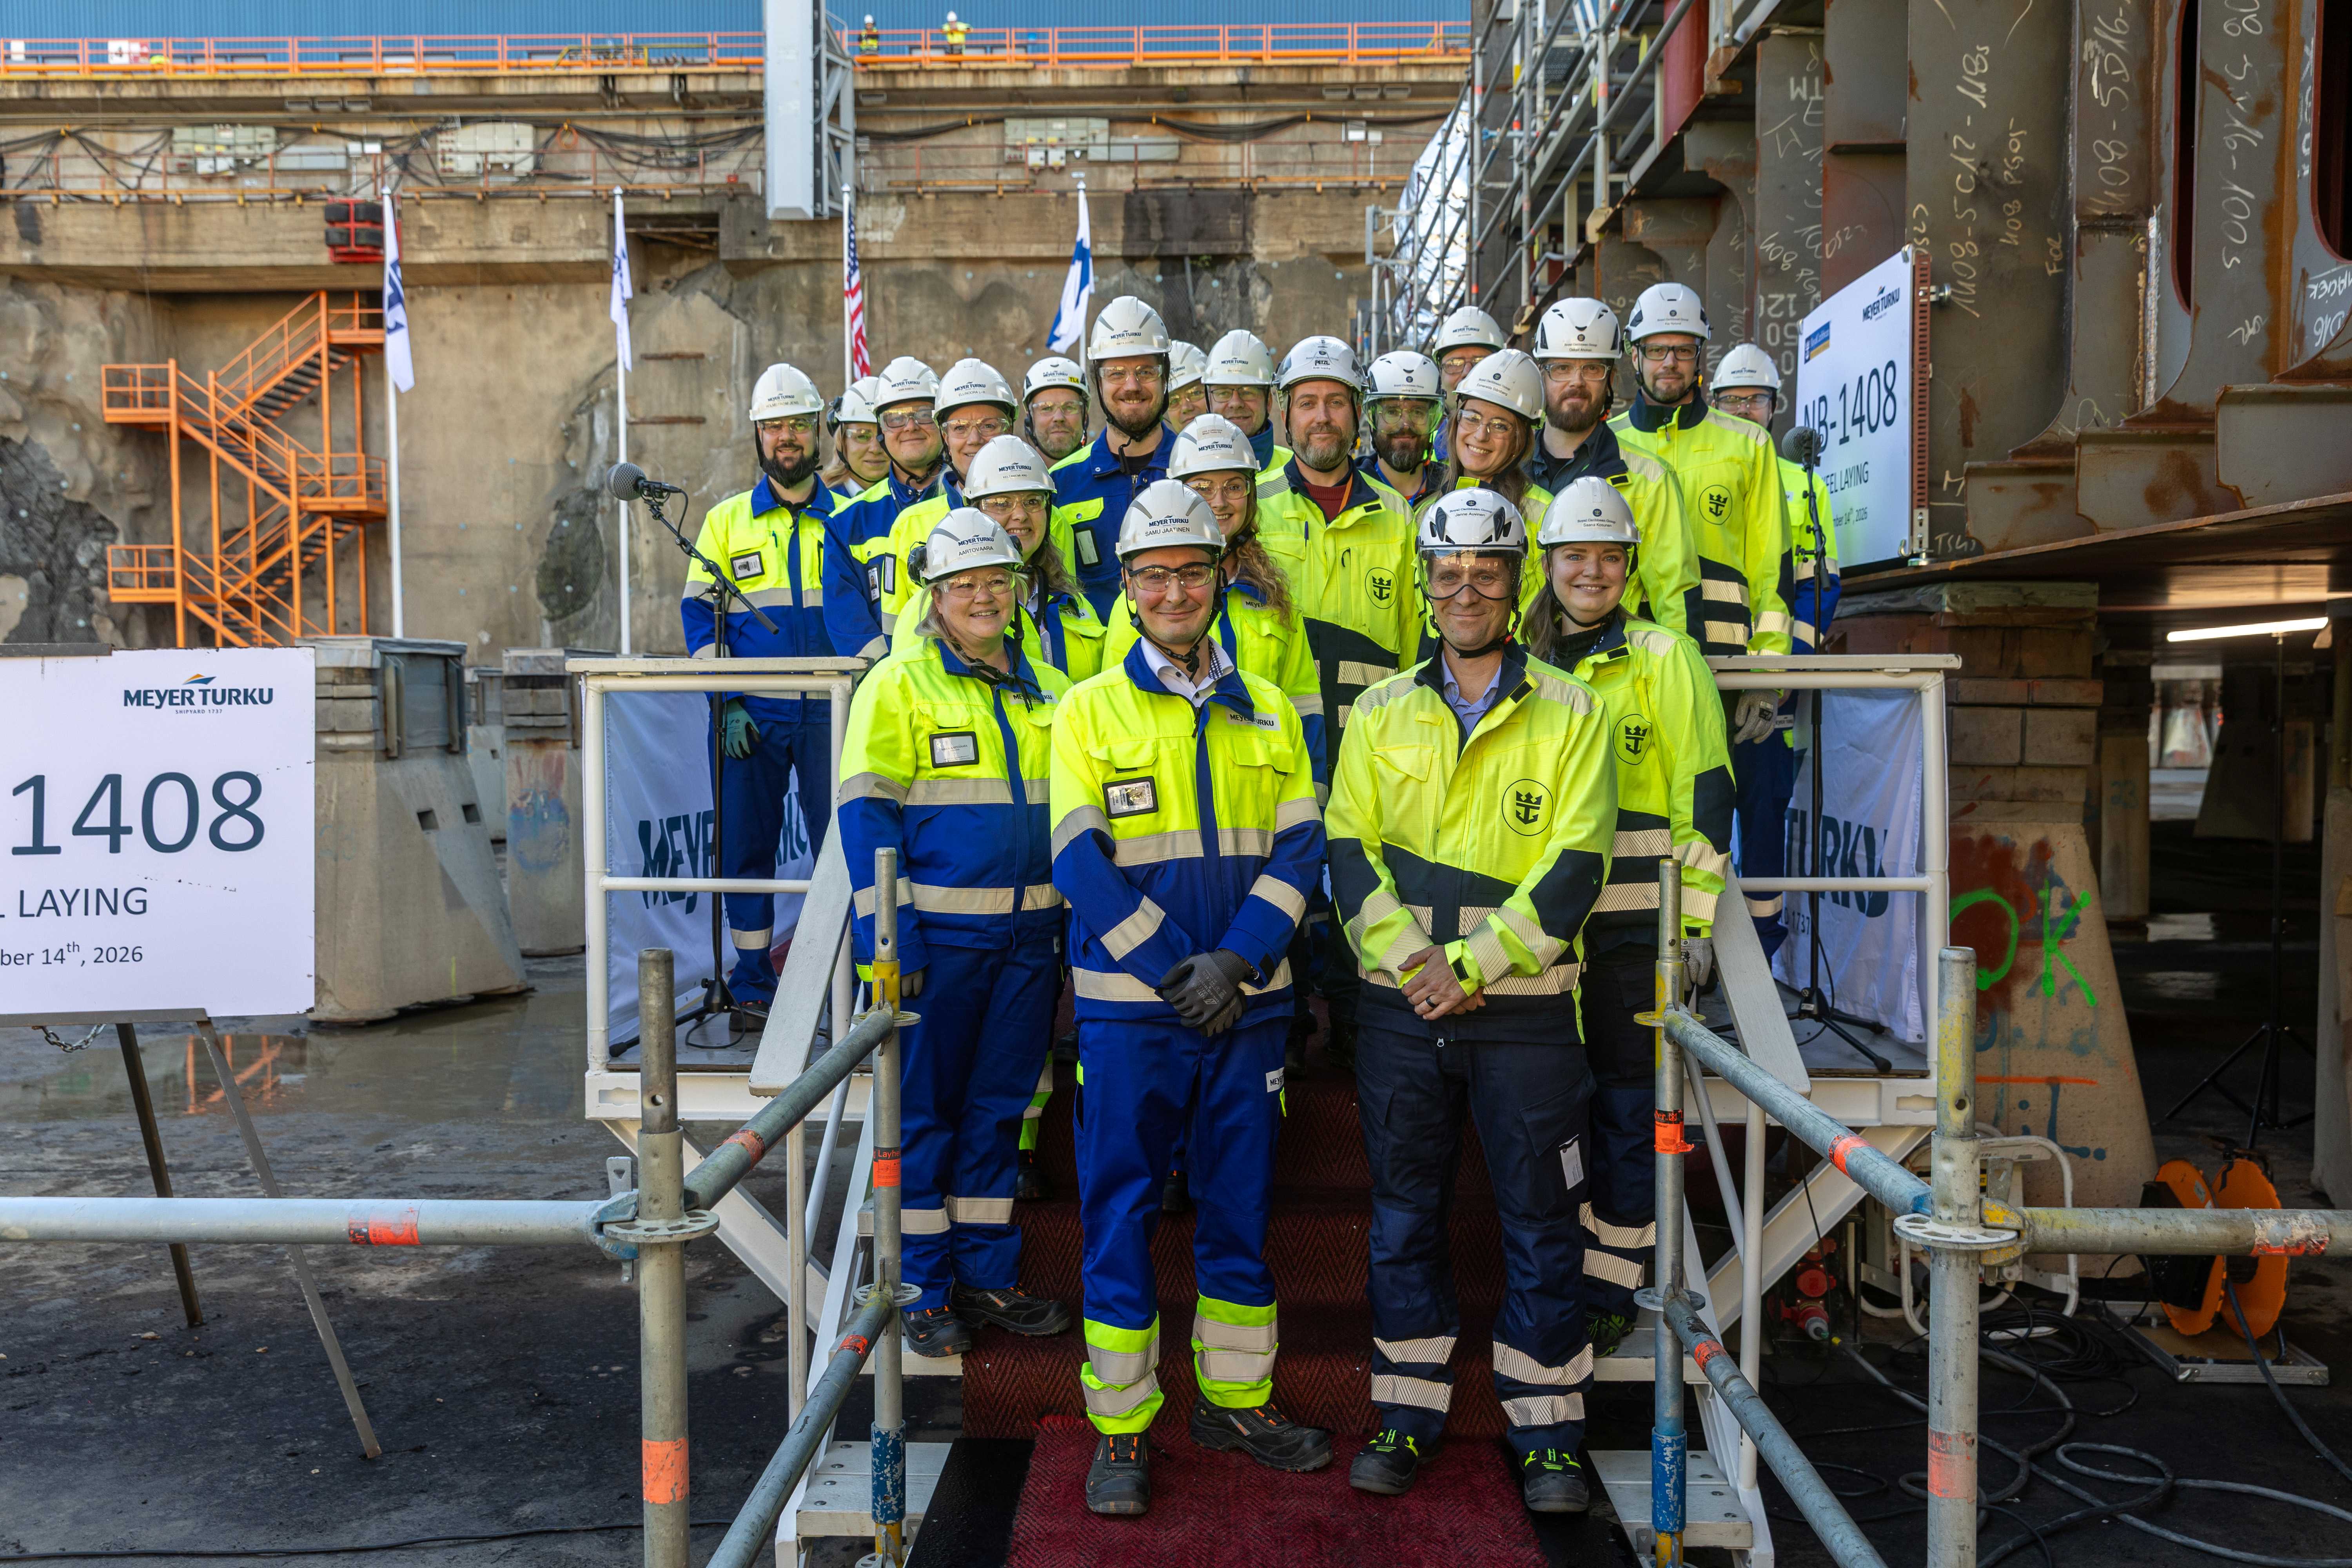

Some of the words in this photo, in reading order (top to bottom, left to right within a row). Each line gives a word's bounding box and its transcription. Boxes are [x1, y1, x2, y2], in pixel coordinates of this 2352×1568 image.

[1862, 300, 1880, 322] MEYER
[1881, 287, 1900, 311] TURKU
[1823, 472, 1838, 494] EEL
[1840, 461, 1868, 491] LAYING
[1856, 507, 1867, 522] 2026
[958, 538, 976, 546] MEYER
[1145, 528, 1161, 537] SAMU
[959, 546, 994, 556] AARTOVAARA
[123, 689, 195, 710] MEYER
[198, 688, 273, 706] TURKU
[1254, 718, 1274, 726] URKU
[11, 771, 265, 855] 1408
[1785, 808, 1889, 918] TURKU
[20, 887, 147, 917] LAYING
[1793, 911, 1809, 935] 1737
[94, 946, 143, 963] 2026
[878, 1149, 901, 1160] Layhe
